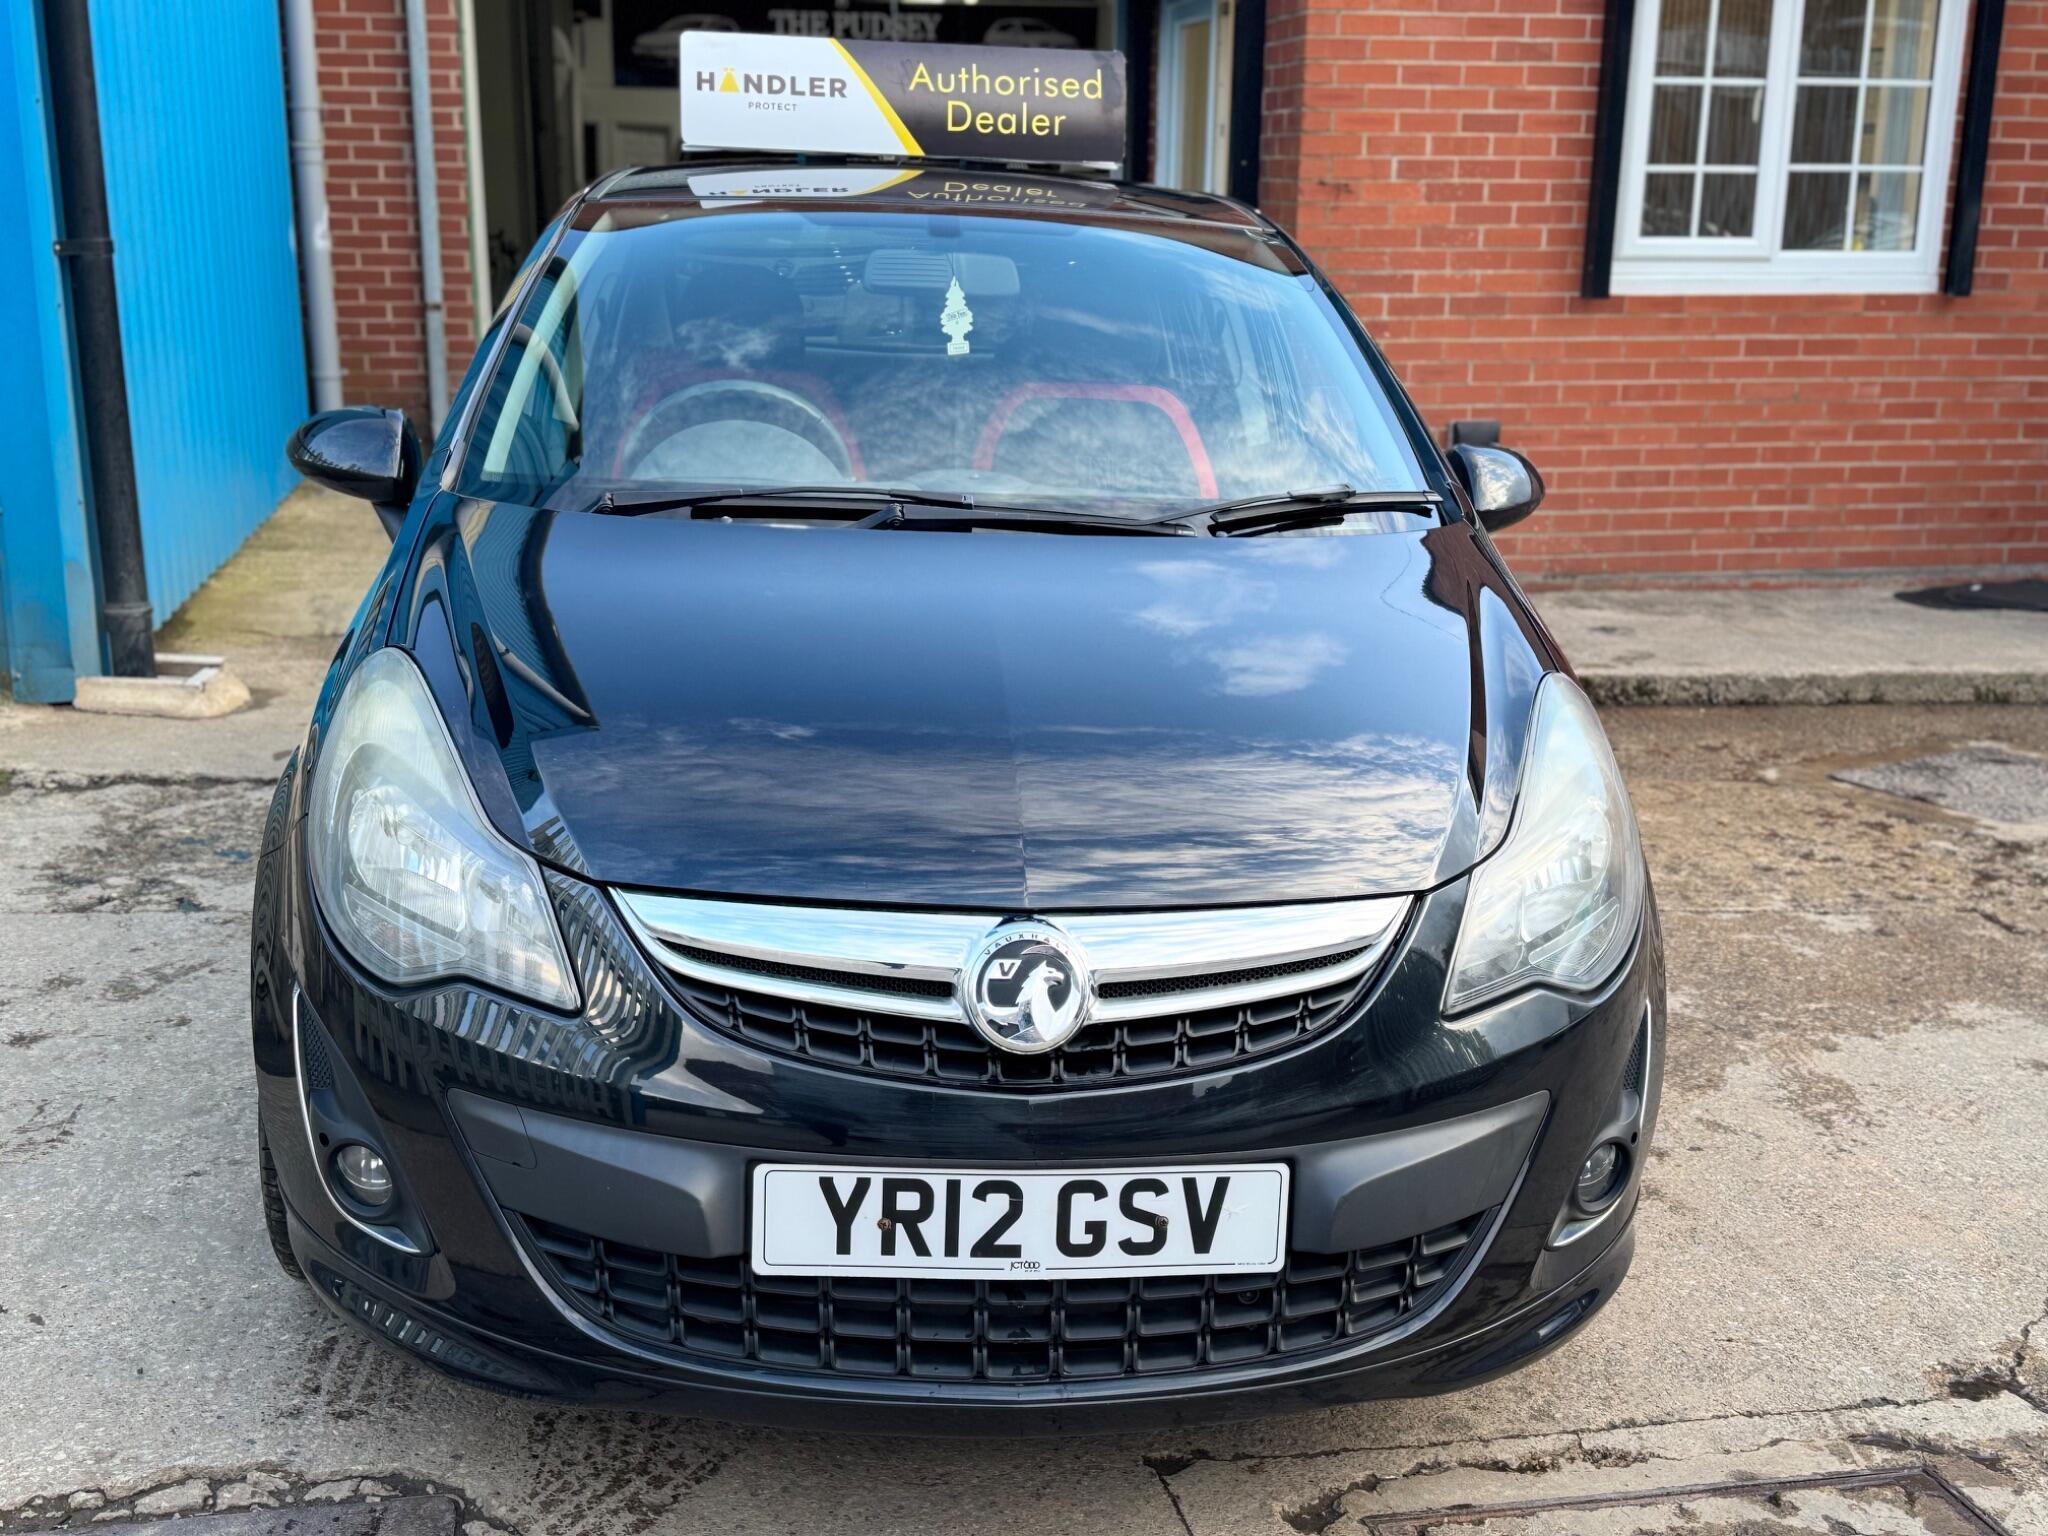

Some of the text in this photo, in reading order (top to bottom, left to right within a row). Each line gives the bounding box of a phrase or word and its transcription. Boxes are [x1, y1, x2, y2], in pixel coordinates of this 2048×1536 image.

[768, 8, 942, 41] THE PUDSEY
[909, 62, 1102, 99] Authorised
[748, 101, 798, 112] PROTECT
[947, 100, 1067, 136] Dealer
[984, 933, 1070, 956] VAUXHALL
[818, 1176, 1231, 1258] YR12 GSV
